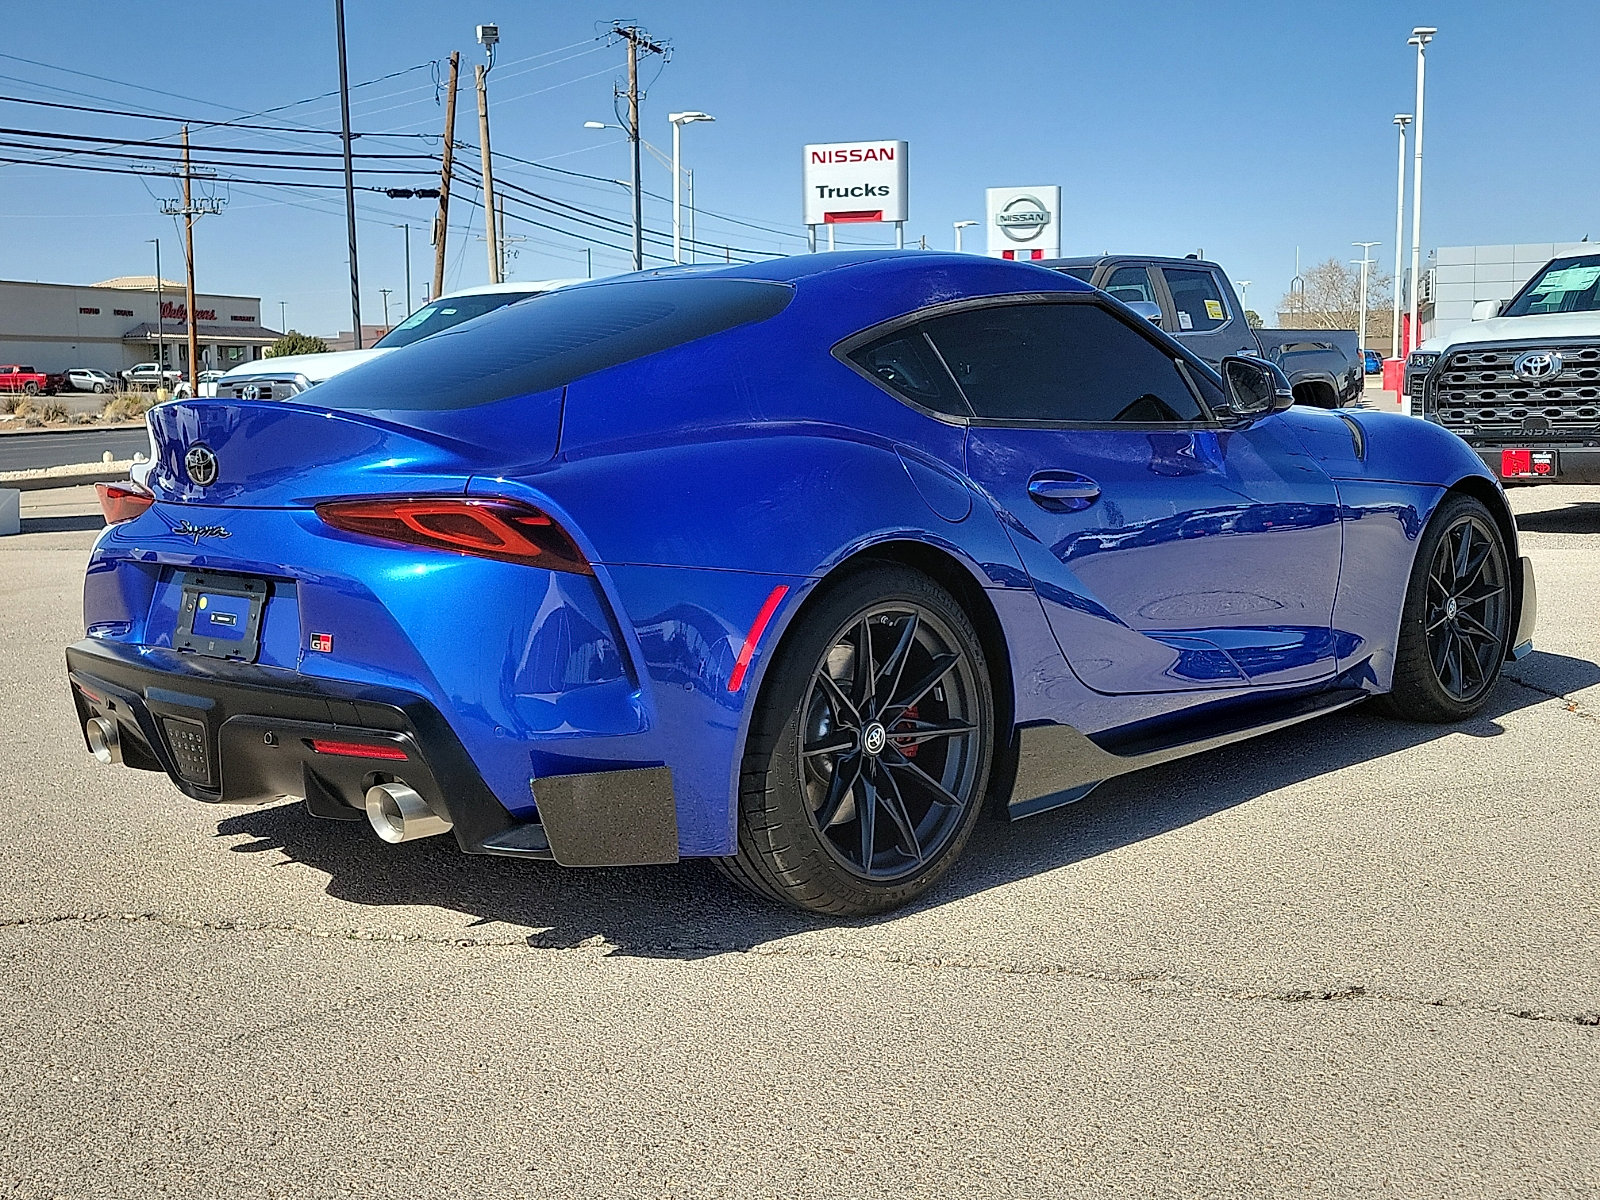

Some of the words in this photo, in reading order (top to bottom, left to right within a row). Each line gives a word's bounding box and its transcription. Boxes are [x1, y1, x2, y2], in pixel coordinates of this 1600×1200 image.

[812, 147, 894, 164] NISSAN
[815, 183, 890, 199] Trucks
[1000, 213, 1044, 222] NISSAN
[171, 519, 233, 546] Supra
[311, 640, 330, 651] GR
